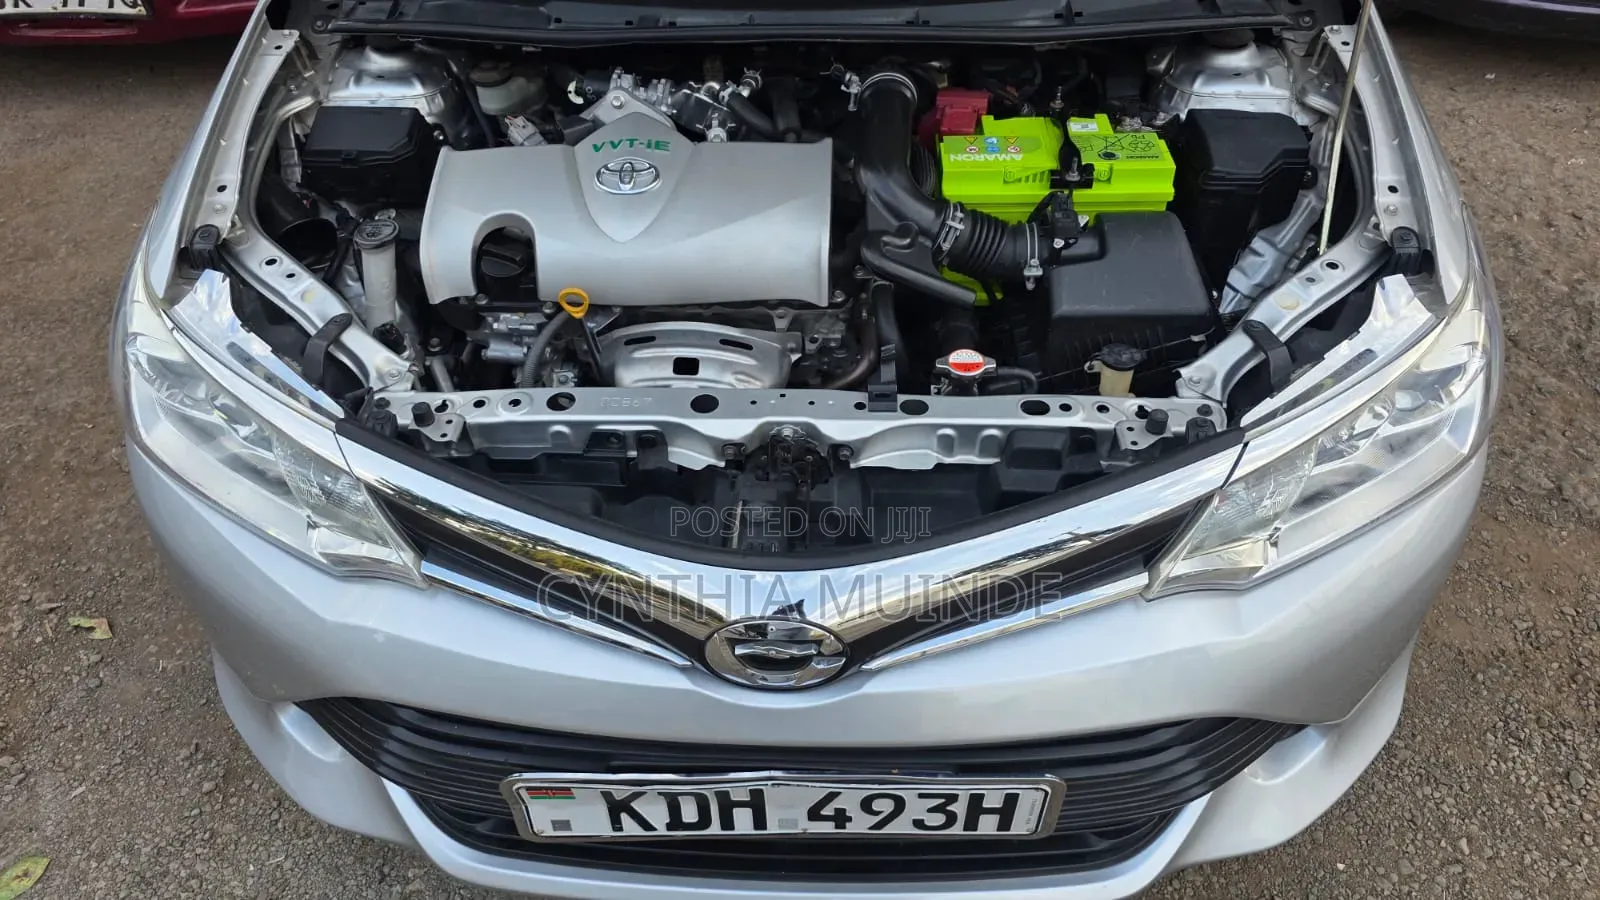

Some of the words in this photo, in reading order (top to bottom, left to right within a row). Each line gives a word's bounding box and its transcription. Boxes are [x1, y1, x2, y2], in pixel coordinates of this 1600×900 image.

[949, 152, 1024, 162] AMARON
[600, 788, 769, 832] KDH
[807, 791, 1021, 832] 493H
